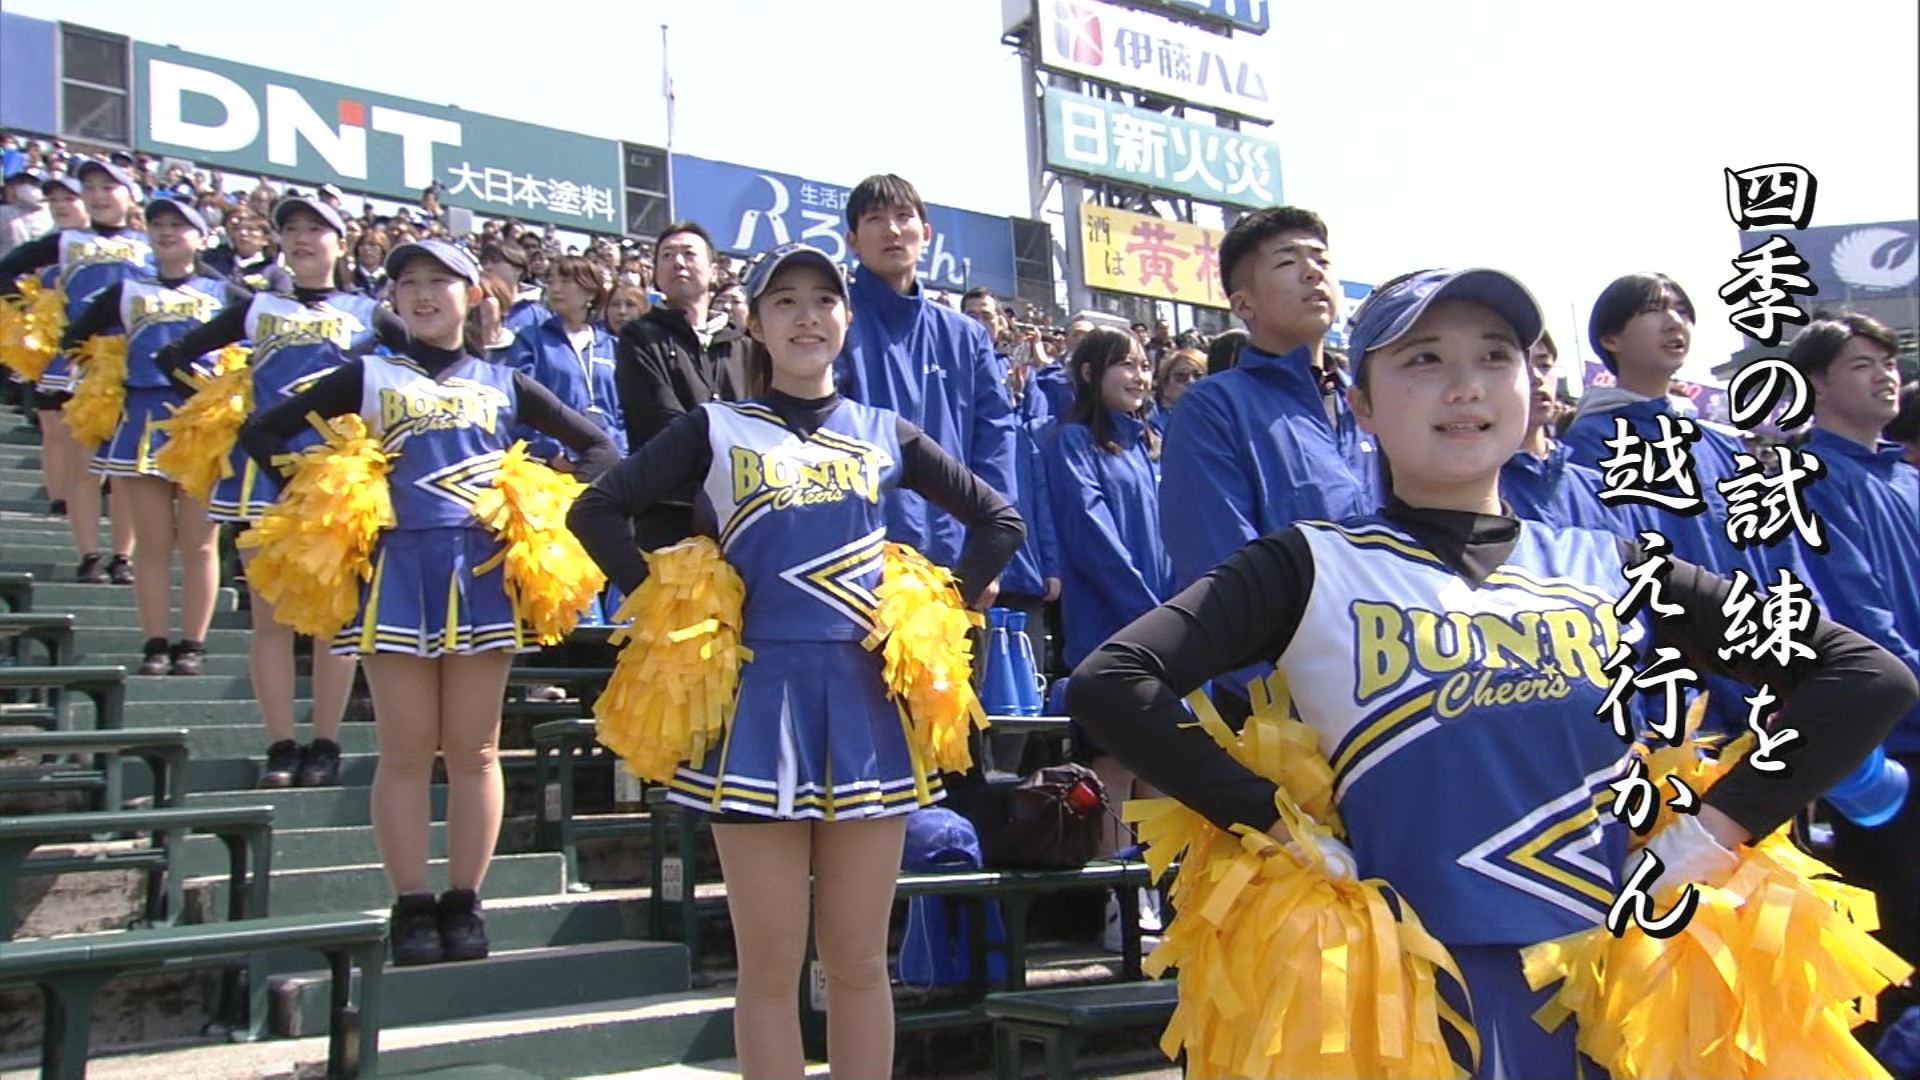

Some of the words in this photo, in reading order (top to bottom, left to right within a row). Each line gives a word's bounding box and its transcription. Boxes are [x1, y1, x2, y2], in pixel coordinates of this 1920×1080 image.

[1114, 27, 1269, 102] 伊藤ハム
[148, 58, 462, 191] DNT
[1060, 98, 1274, 202] 日新火災
[447, 161, 616, 222] 大日本塗料
[801, 210, 970, 285] ろん
[1087, 214, 1126, 277] 酒は
[729, 446, 882, 505] BUNRI
[1351, 600, 1621, 703] BUNRI
[1435, 670, 1572, 719] Cheers
